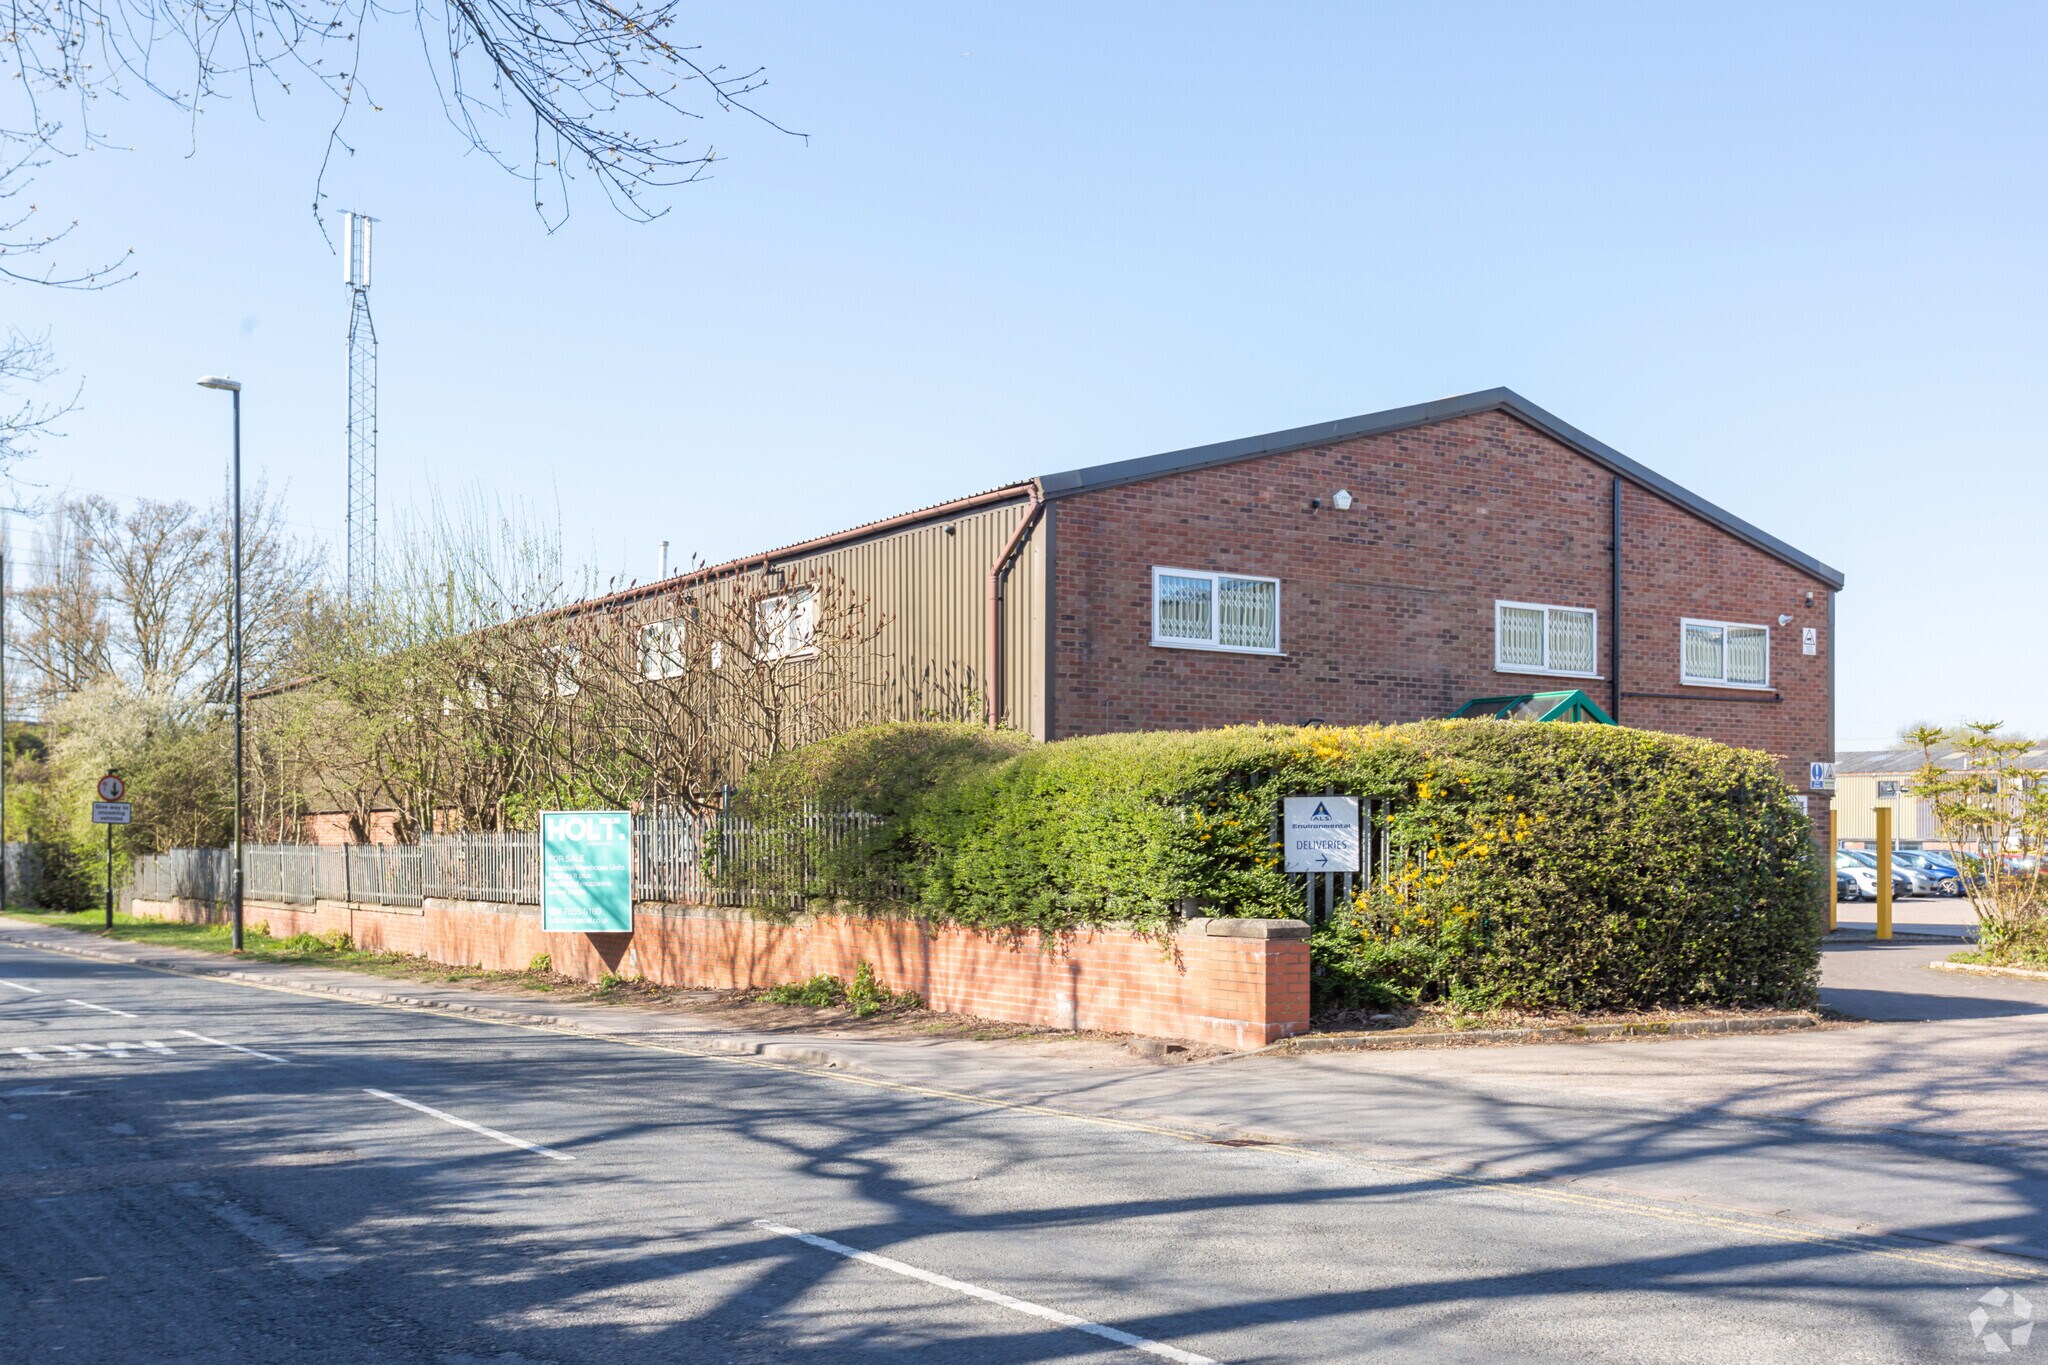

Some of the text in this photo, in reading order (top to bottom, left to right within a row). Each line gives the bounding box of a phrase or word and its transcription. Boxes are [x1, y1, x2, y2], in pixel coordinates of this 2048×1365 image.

[1296, 840, 1347, 850] DELIVERIES
[548, 854, 585, 862] FOR SALE
